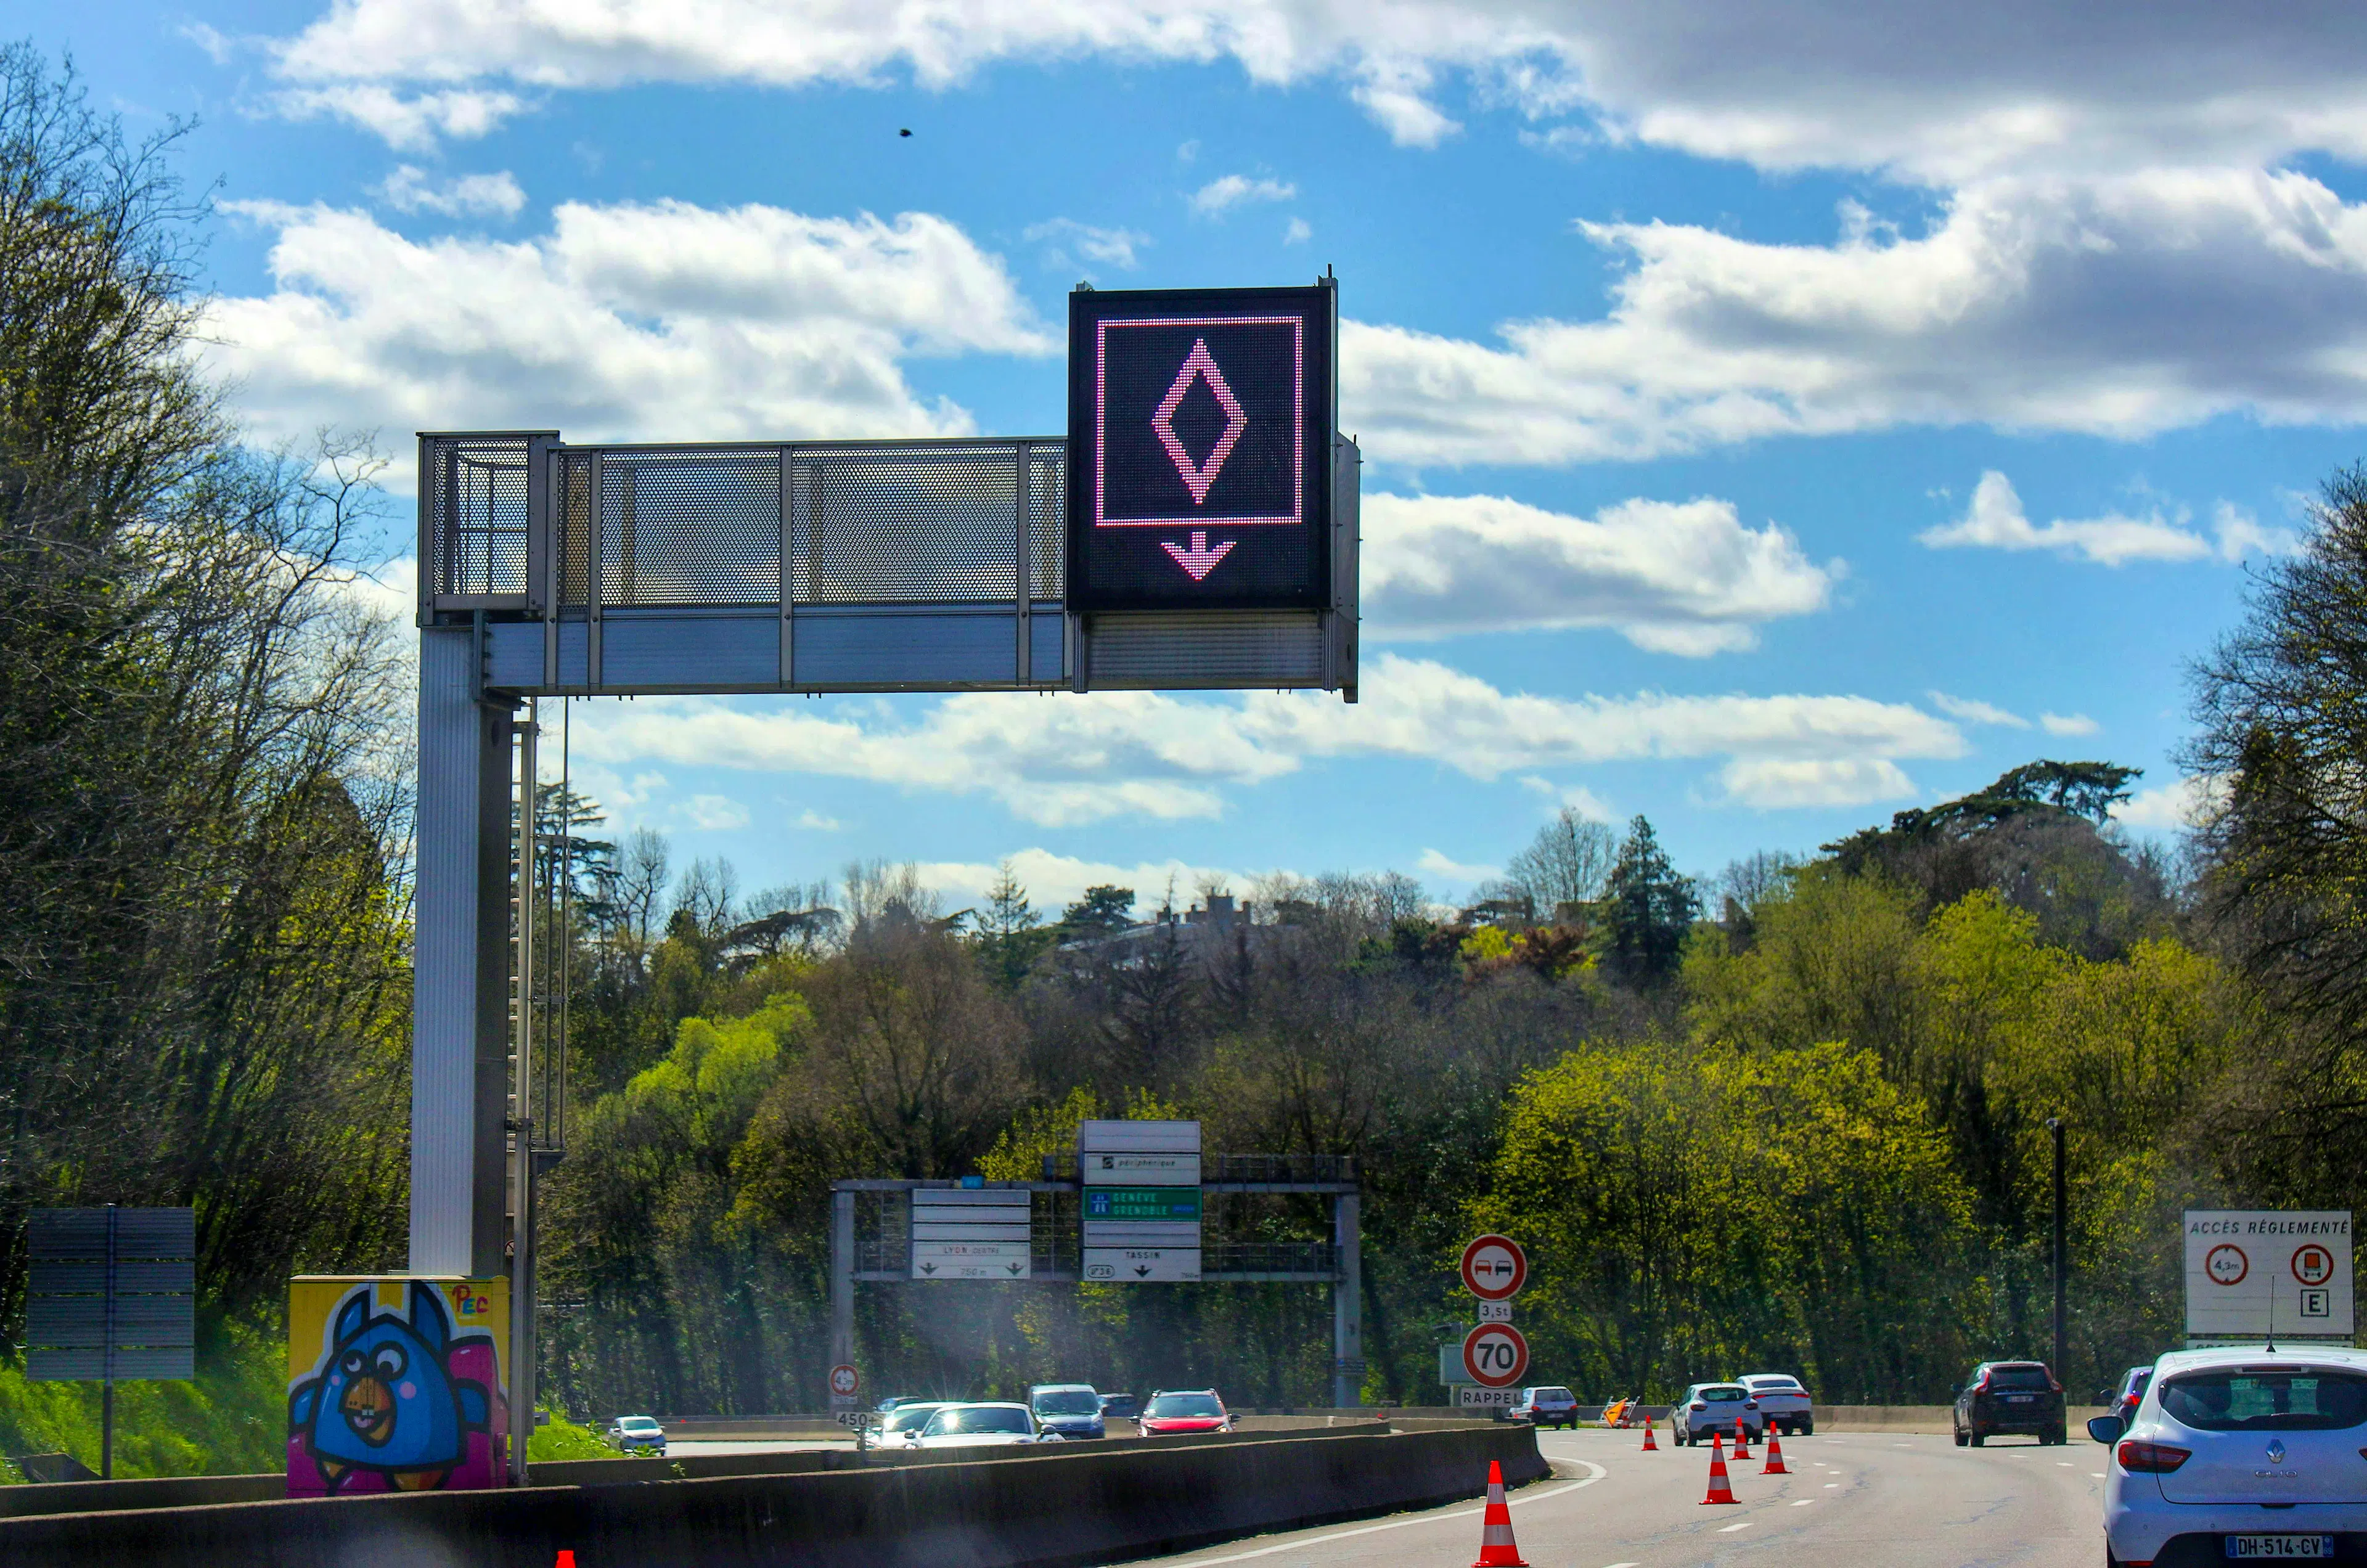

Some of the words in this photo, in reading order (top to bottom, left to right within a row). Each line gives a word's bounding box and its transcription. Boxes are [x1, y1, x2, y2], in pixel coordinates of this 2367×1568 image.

[1113, 1206, 1168, 1215] GRENOBLE
[2248, 1219, 2349, 1233] RÉGLEMENTÉ
[1126, 1251, 1161, 1259] TASSIN
[961, 1268, 978, 1276] 750
[2308, 1294, 2321, 1313] E
[1481, 1305, 1508, 1318] 3,5t
[1478, 1343, 1514, 1370] 70
[1463, 1392, 1522, 1404] RAPPEL
[2255, 1470, 2298, 1478] CLIO
[2238, 1538, 2320, 1555] DH-514-CV
